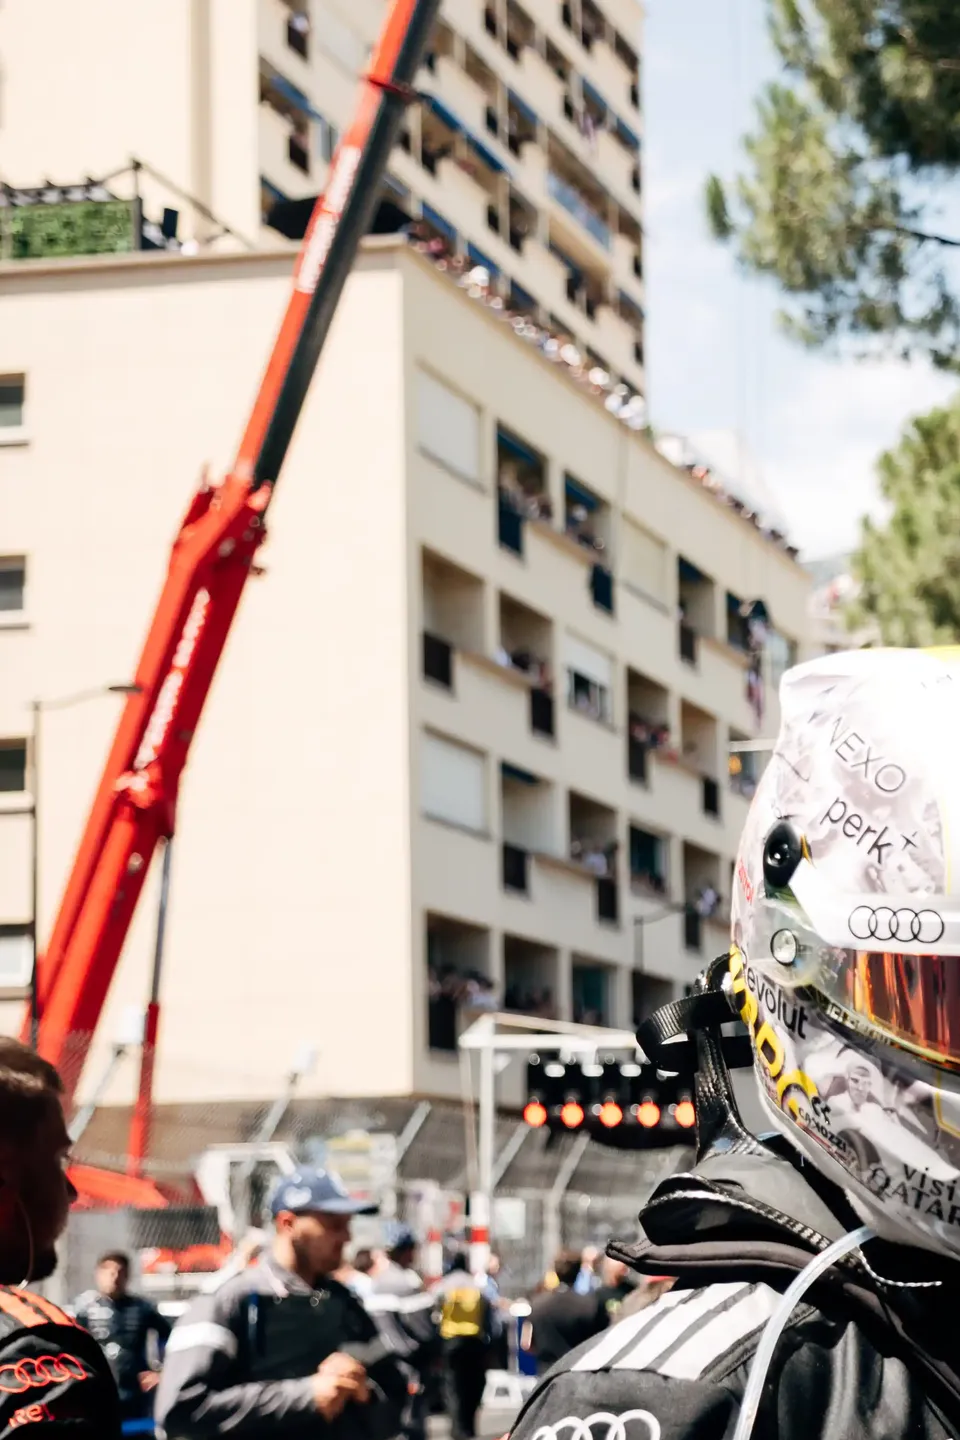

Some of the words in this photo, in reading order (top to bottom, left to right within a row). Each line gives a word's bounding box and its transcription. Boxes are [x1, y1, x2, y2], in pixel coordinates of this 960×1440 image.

[830, 716, 906, 793] NEXO
[820, 797, 892, 865] perk
[743, 963, 809, 1040] evolut
